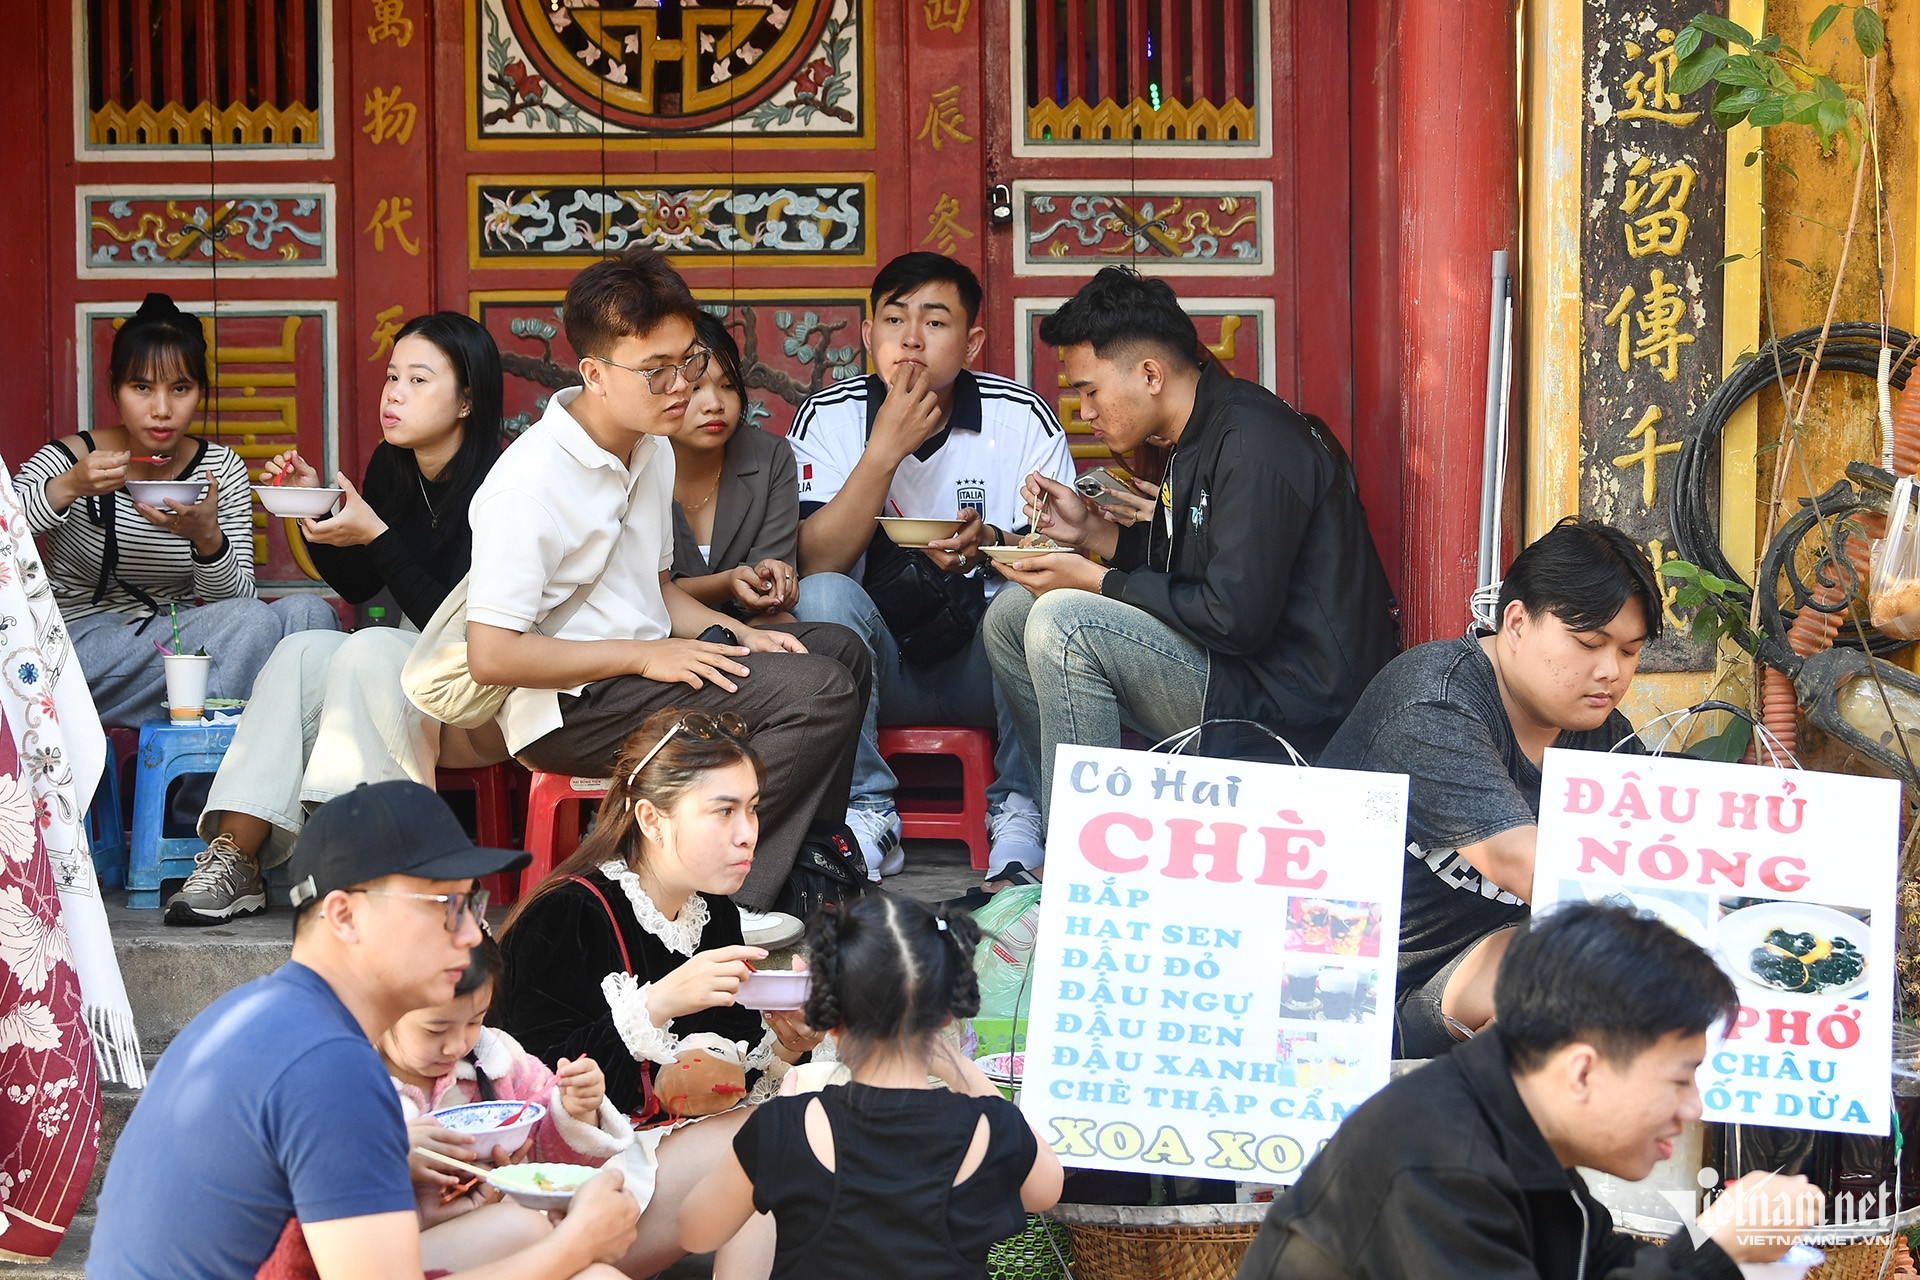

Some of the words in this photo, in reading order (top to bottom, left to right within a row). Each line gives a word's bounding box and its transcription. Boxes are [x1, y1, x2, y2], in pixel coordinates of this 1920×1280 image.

[797, 481, 812, 493] LIA
[959, 490, 983, 500] ITALIA
[1070, 760, 1132, 797] Cô
[1151, 767, 1242, 807] Hai
[1562, 770, 1699, 829] ĐẬU
[1718, 780, 1808, 834] HỦ
[1078, 809, 1328, 890] CHÈ
[1576, 834, 1812, 893] NÓNG
[1068, 876, 1150, 909] BẮP
[1065, 915, 1151, 943] HẠT
[1161, 924, 1242, 950] SEN
[1061, 944, 1151, 976] ĐẬU
[1162, 951, 1221, 980] ĐỎ
[1058, 977, 1147, 1009] ĐẬU
[1160, 988, 1254, 1021] NGỰ
[1055, 1010, 1144, 1042] ĐẬU
[1156, 1021, 1244, 1048] ĐEN
[1721, 1003, 1862, 1050] PHỚ
[1051, 1043, 1142, 1076] ĐẬU
[1153, 1053, 1278, 1084] XANH
[1711, 1050, 1838, 1083] CHÂU
[1048, 1078, 1132, 1106] CHÈ
[1143, 1086, 1258, 1119] THẬP
[1269, 1087, 1360, 1122] CẨM
[1702, 1077, 1763, 1114] ỐT
[1773, 1089, 1872, 1124] DỪA
[1049, 1116, 1195, 1166] XOA
[1204, 1130, 1330, 1174] XO
